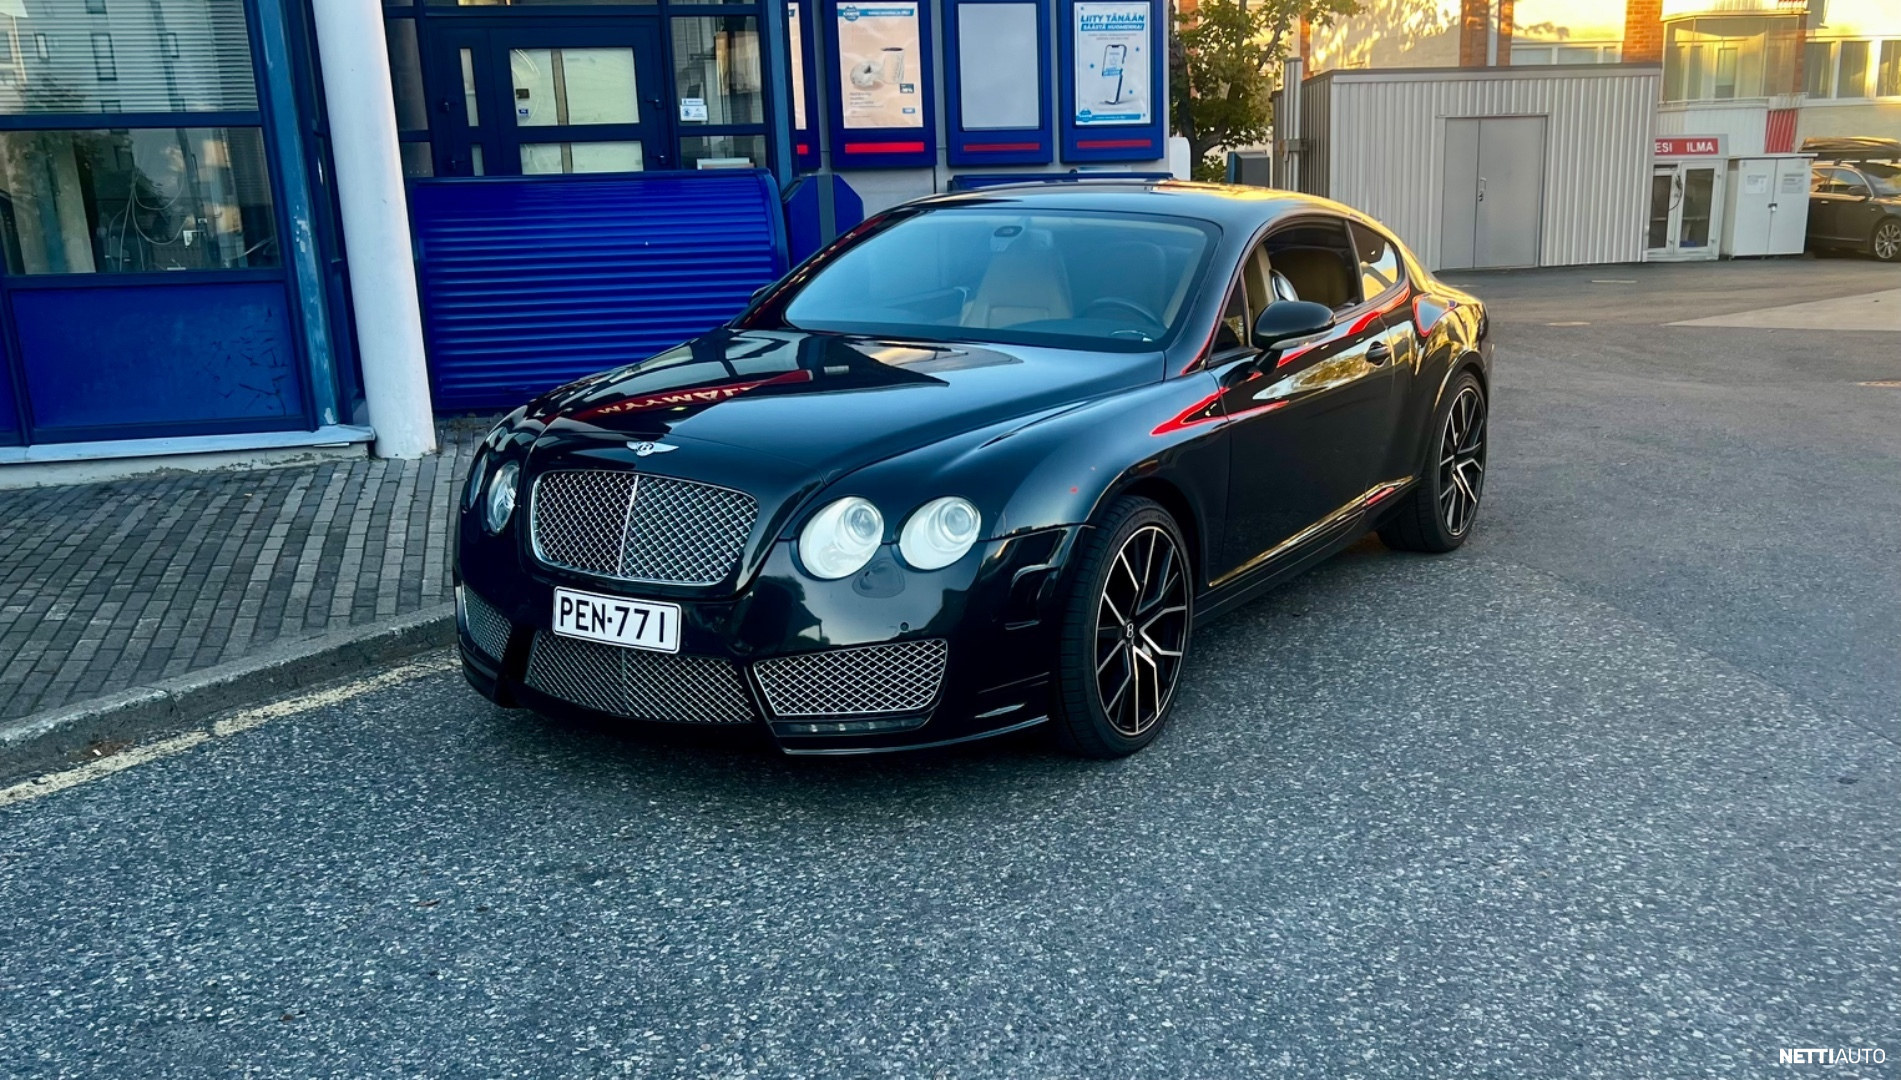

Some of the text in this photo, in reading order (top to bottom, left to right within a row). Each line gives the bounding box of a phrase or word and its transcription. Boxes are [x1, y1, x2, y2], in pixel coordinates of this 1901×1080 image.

[1080, 12, 1145, 22] LIITY TÄNÄÄN
[1686, 142, 1714, 153] ILMA
[560, 596, 665, 643] PEN-771
